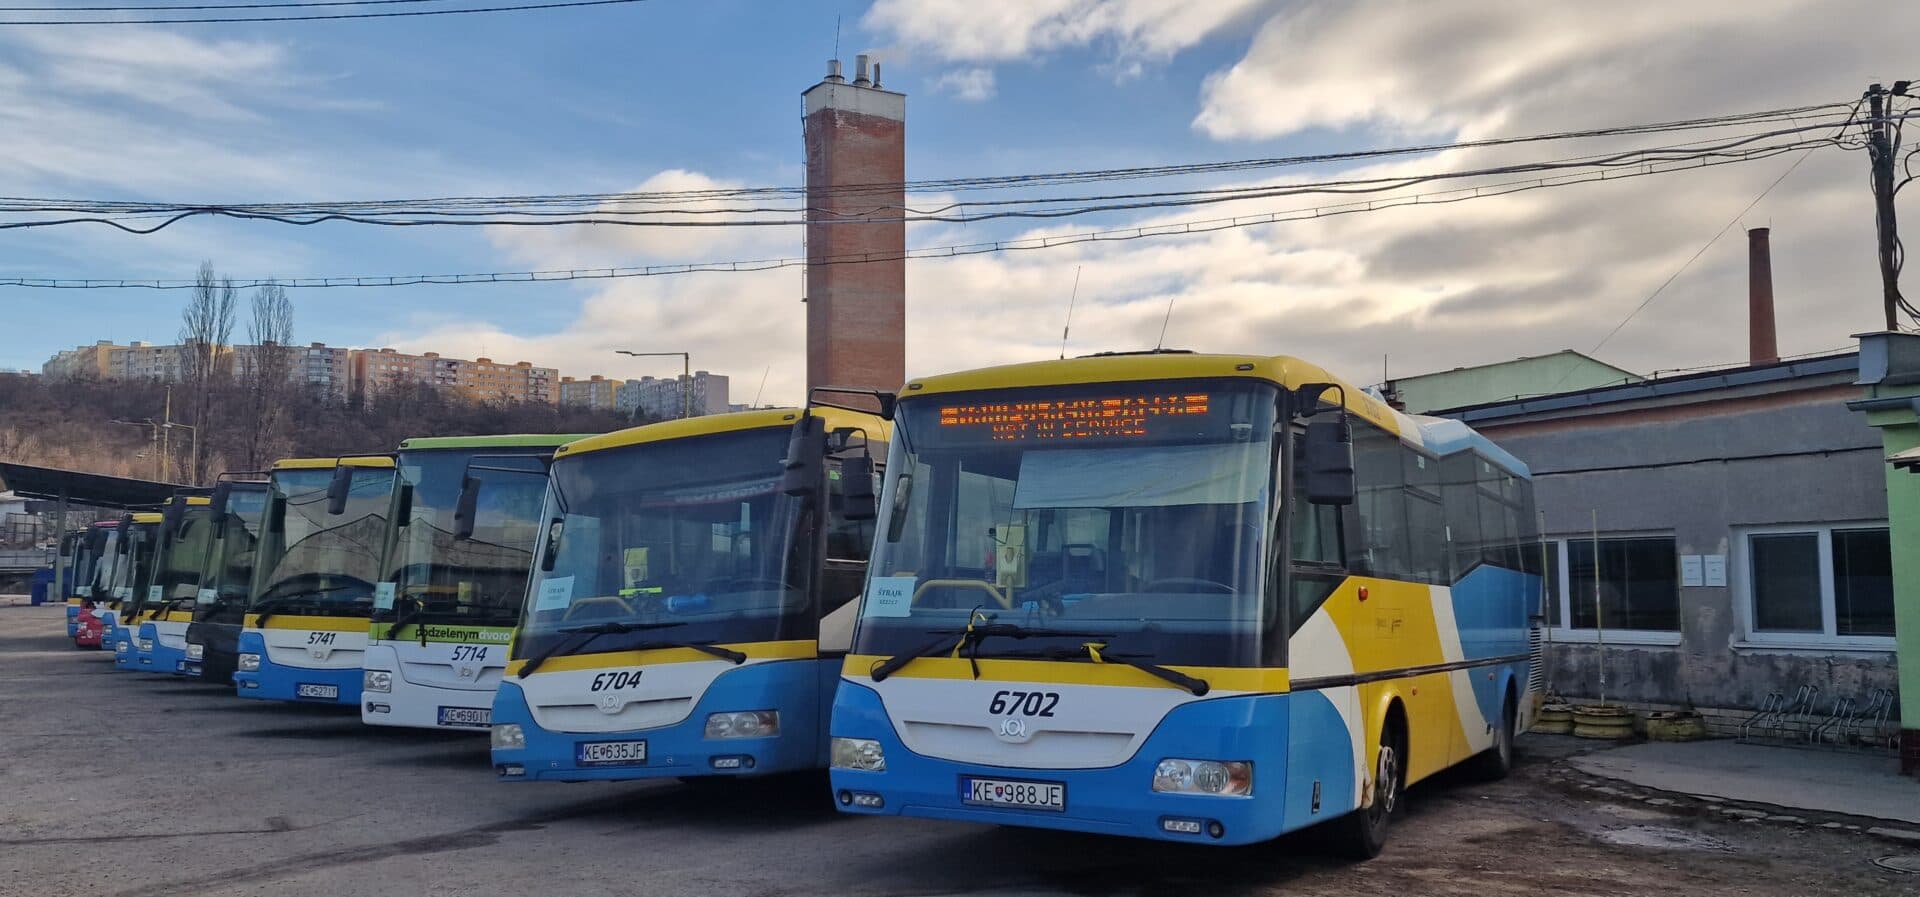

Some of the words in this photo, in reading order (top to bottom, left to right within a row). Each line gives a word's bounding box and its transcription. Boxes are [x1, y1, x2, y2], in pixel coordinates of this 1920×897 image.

[307, 632, 336, 645] 5741
[416, 627, 512, 641] podzelenymdvoro
[451, 645, 488, 661] 5714
[591, 670, 643, 692] 6704
[989, 690, 1060, 717] 6702
